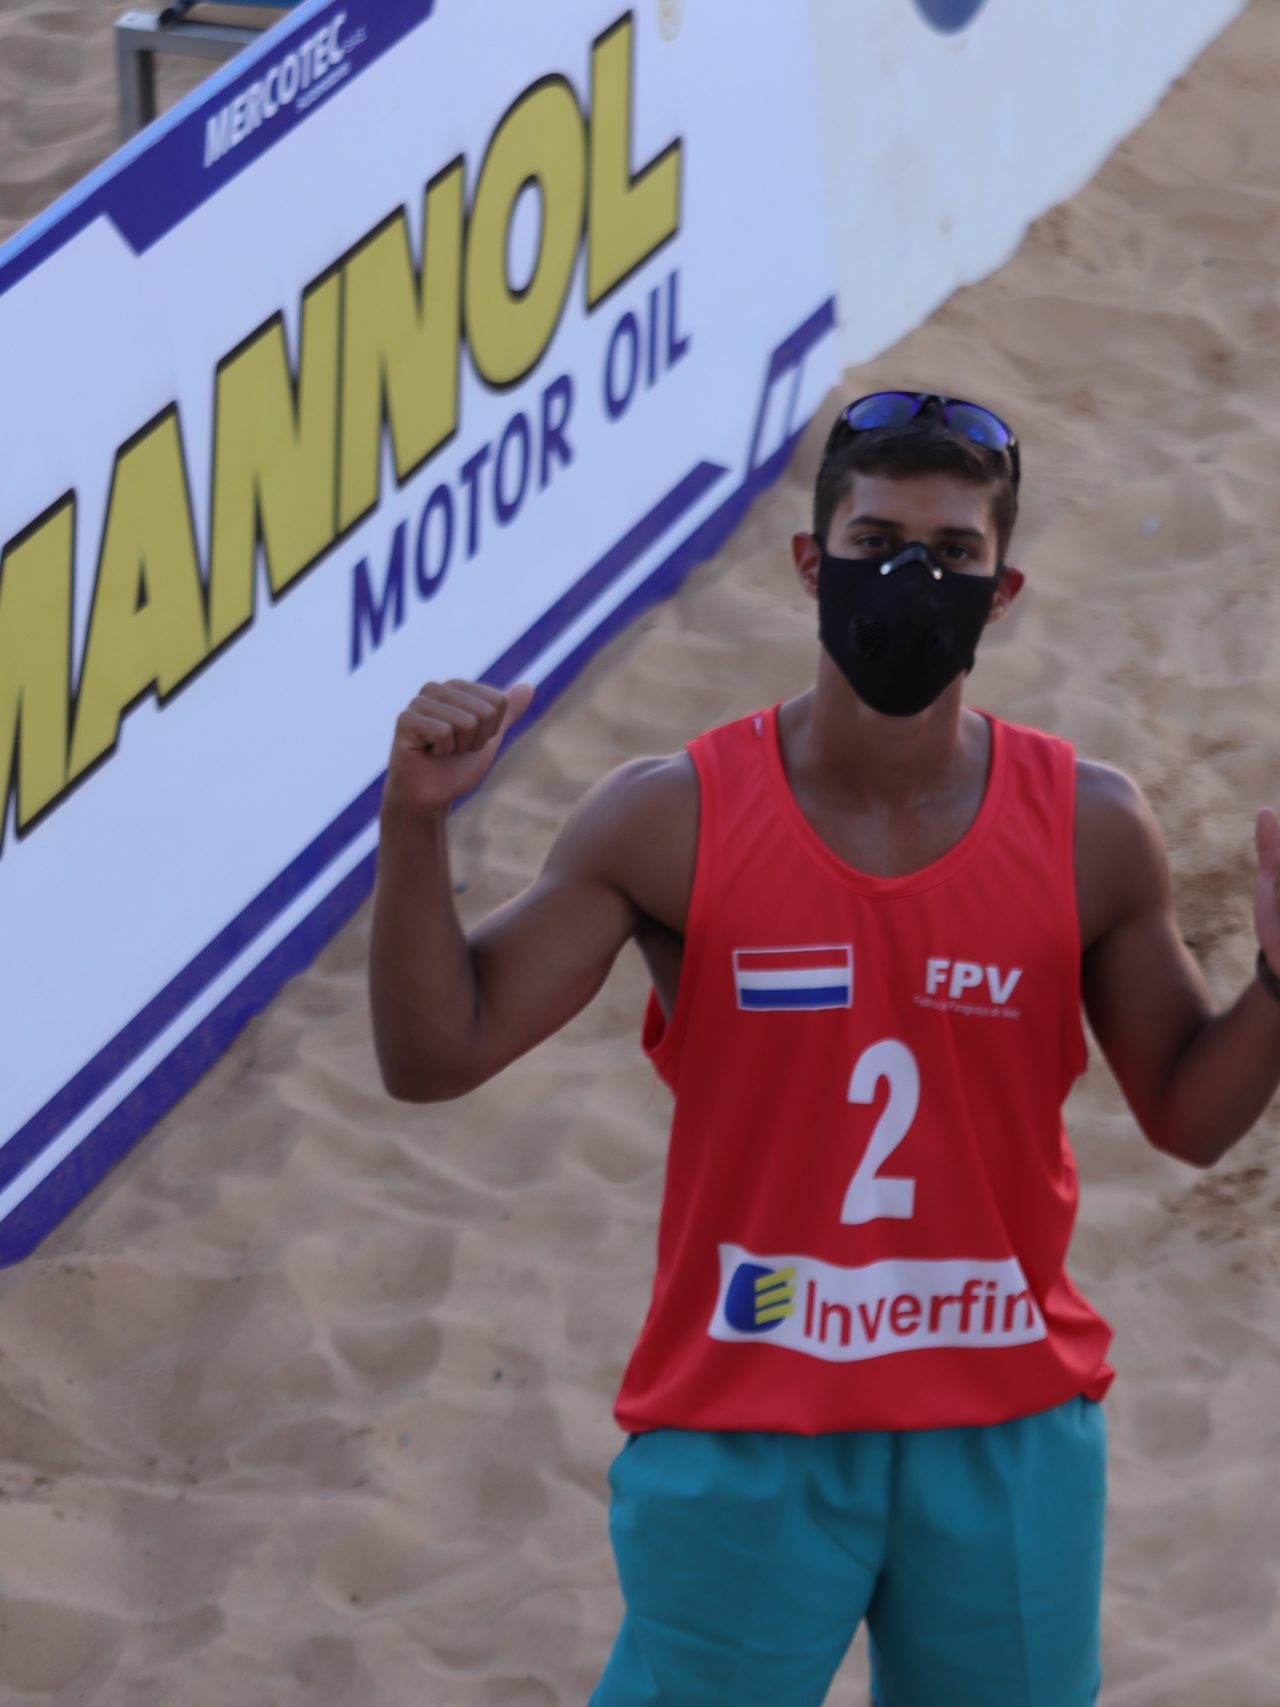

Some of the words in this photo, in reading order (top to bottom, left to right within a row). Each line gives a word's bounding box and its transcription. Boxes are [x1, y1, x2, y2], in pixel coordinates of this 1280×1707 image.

[204, 10, 347, 169] MERCOTEC
[349, 371, 577, 675] MOTOR
[604, 268, 692, 425] OIL
[925, 956, 1023, 1005] FPV
[840, 1038, 921, 1225] 2
[803, 1278, 1035, 1347] Inverfin
